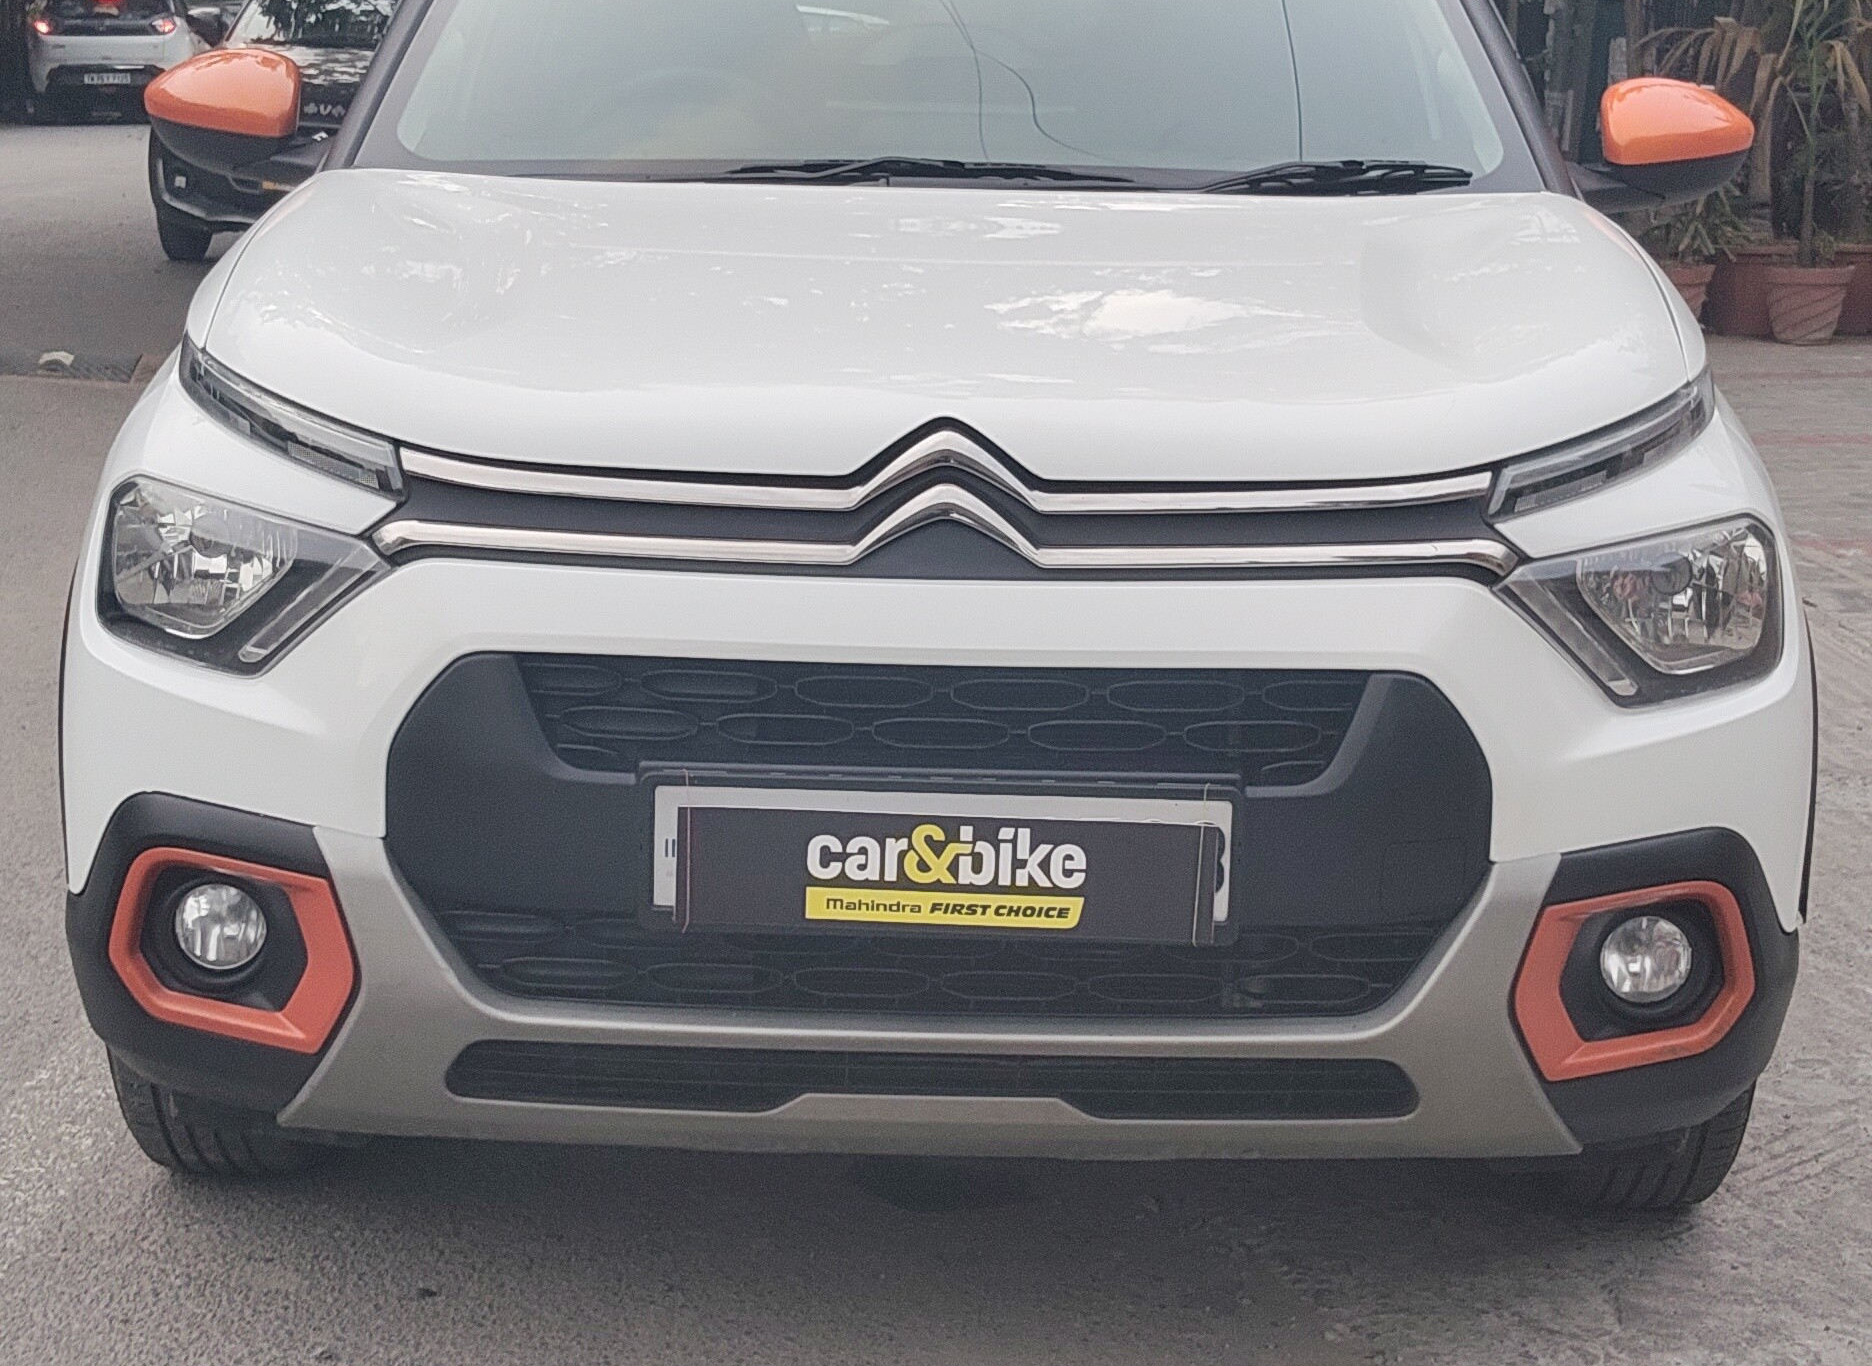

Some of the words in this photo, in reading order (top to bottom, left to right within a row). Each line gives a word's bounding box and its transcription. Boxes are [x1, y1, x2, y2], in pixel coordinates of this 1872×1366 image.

[806, 824, 1087, 889] car&bike
[825, 897, 922, 914] Mahindra
[929, 902, 991, 917] FIRST
[994, 904, 1071, 919] CHOICE
